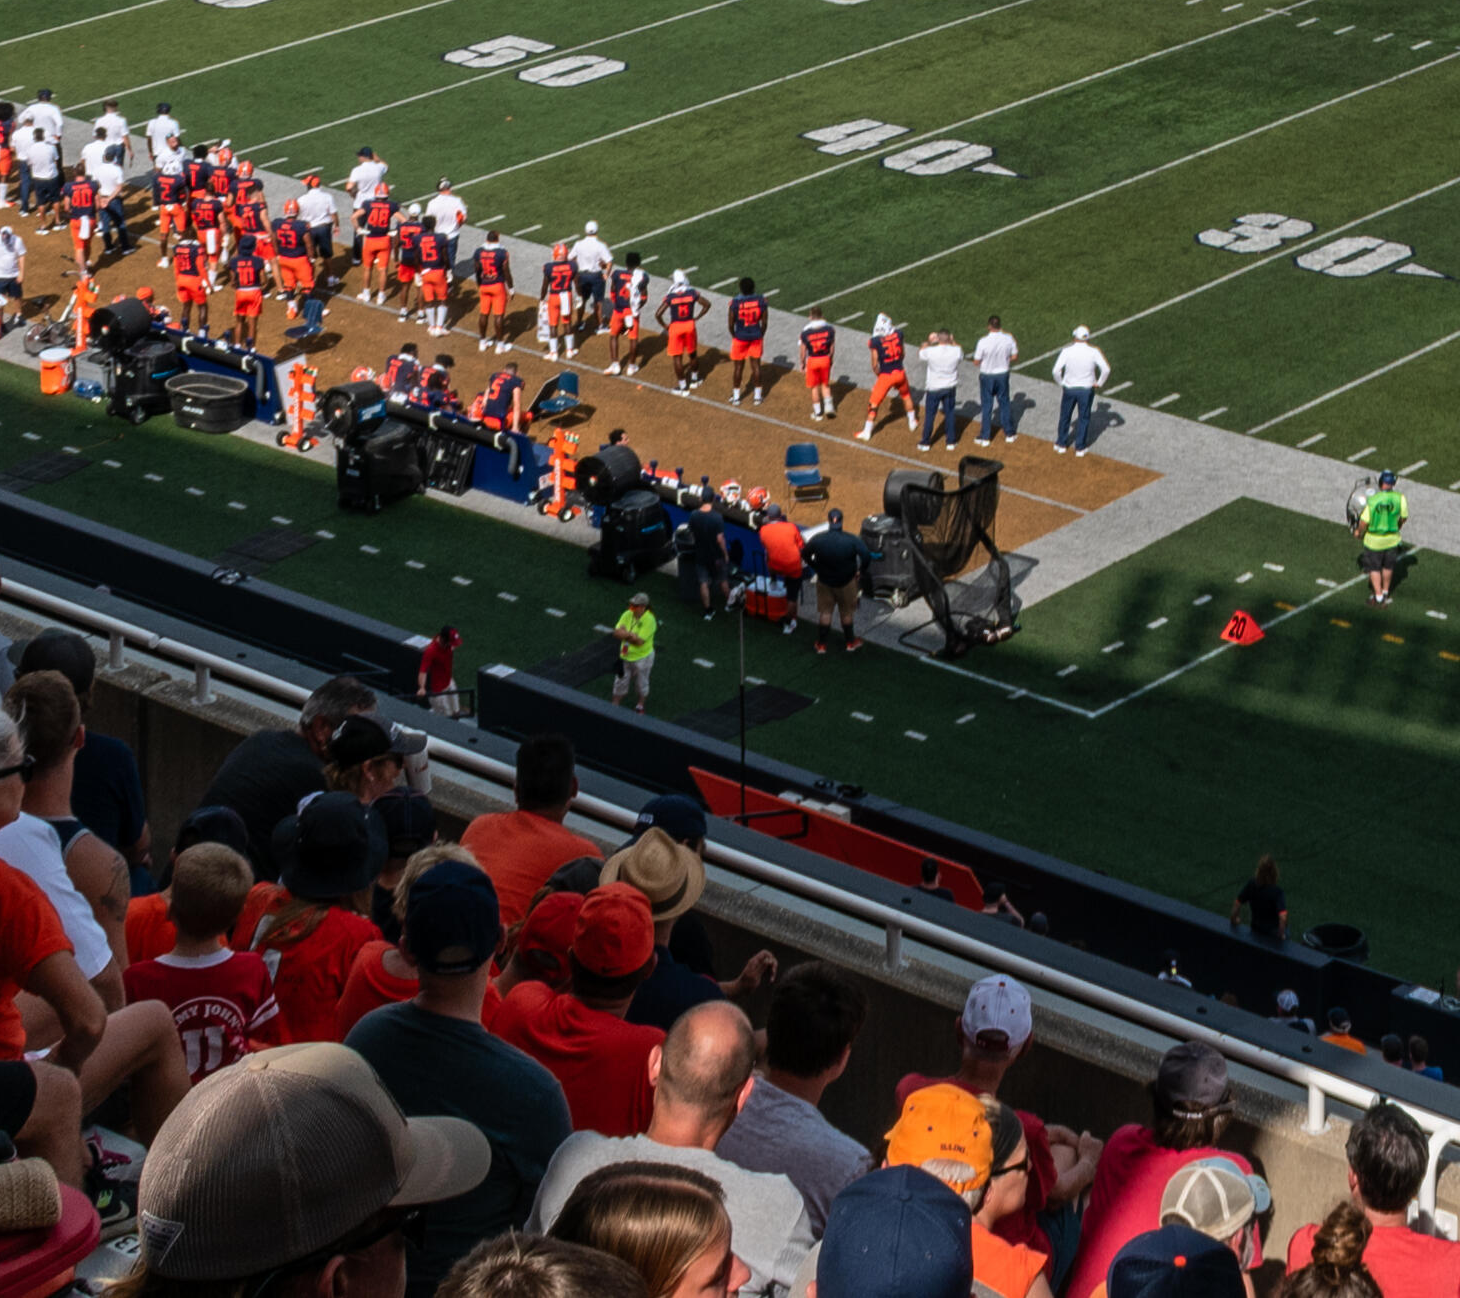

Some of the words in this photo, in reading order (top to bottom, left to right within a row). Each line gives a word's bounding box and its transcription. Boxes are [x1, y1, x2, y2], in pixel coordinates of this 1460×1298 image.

[440, 33, 629, 89] 50
[801, 117, 998, 178] 40
[1194, 211, 1416, 280] 30
[551, 272, 572, 290] 27
[1228, 615, 1247, 640] 20
